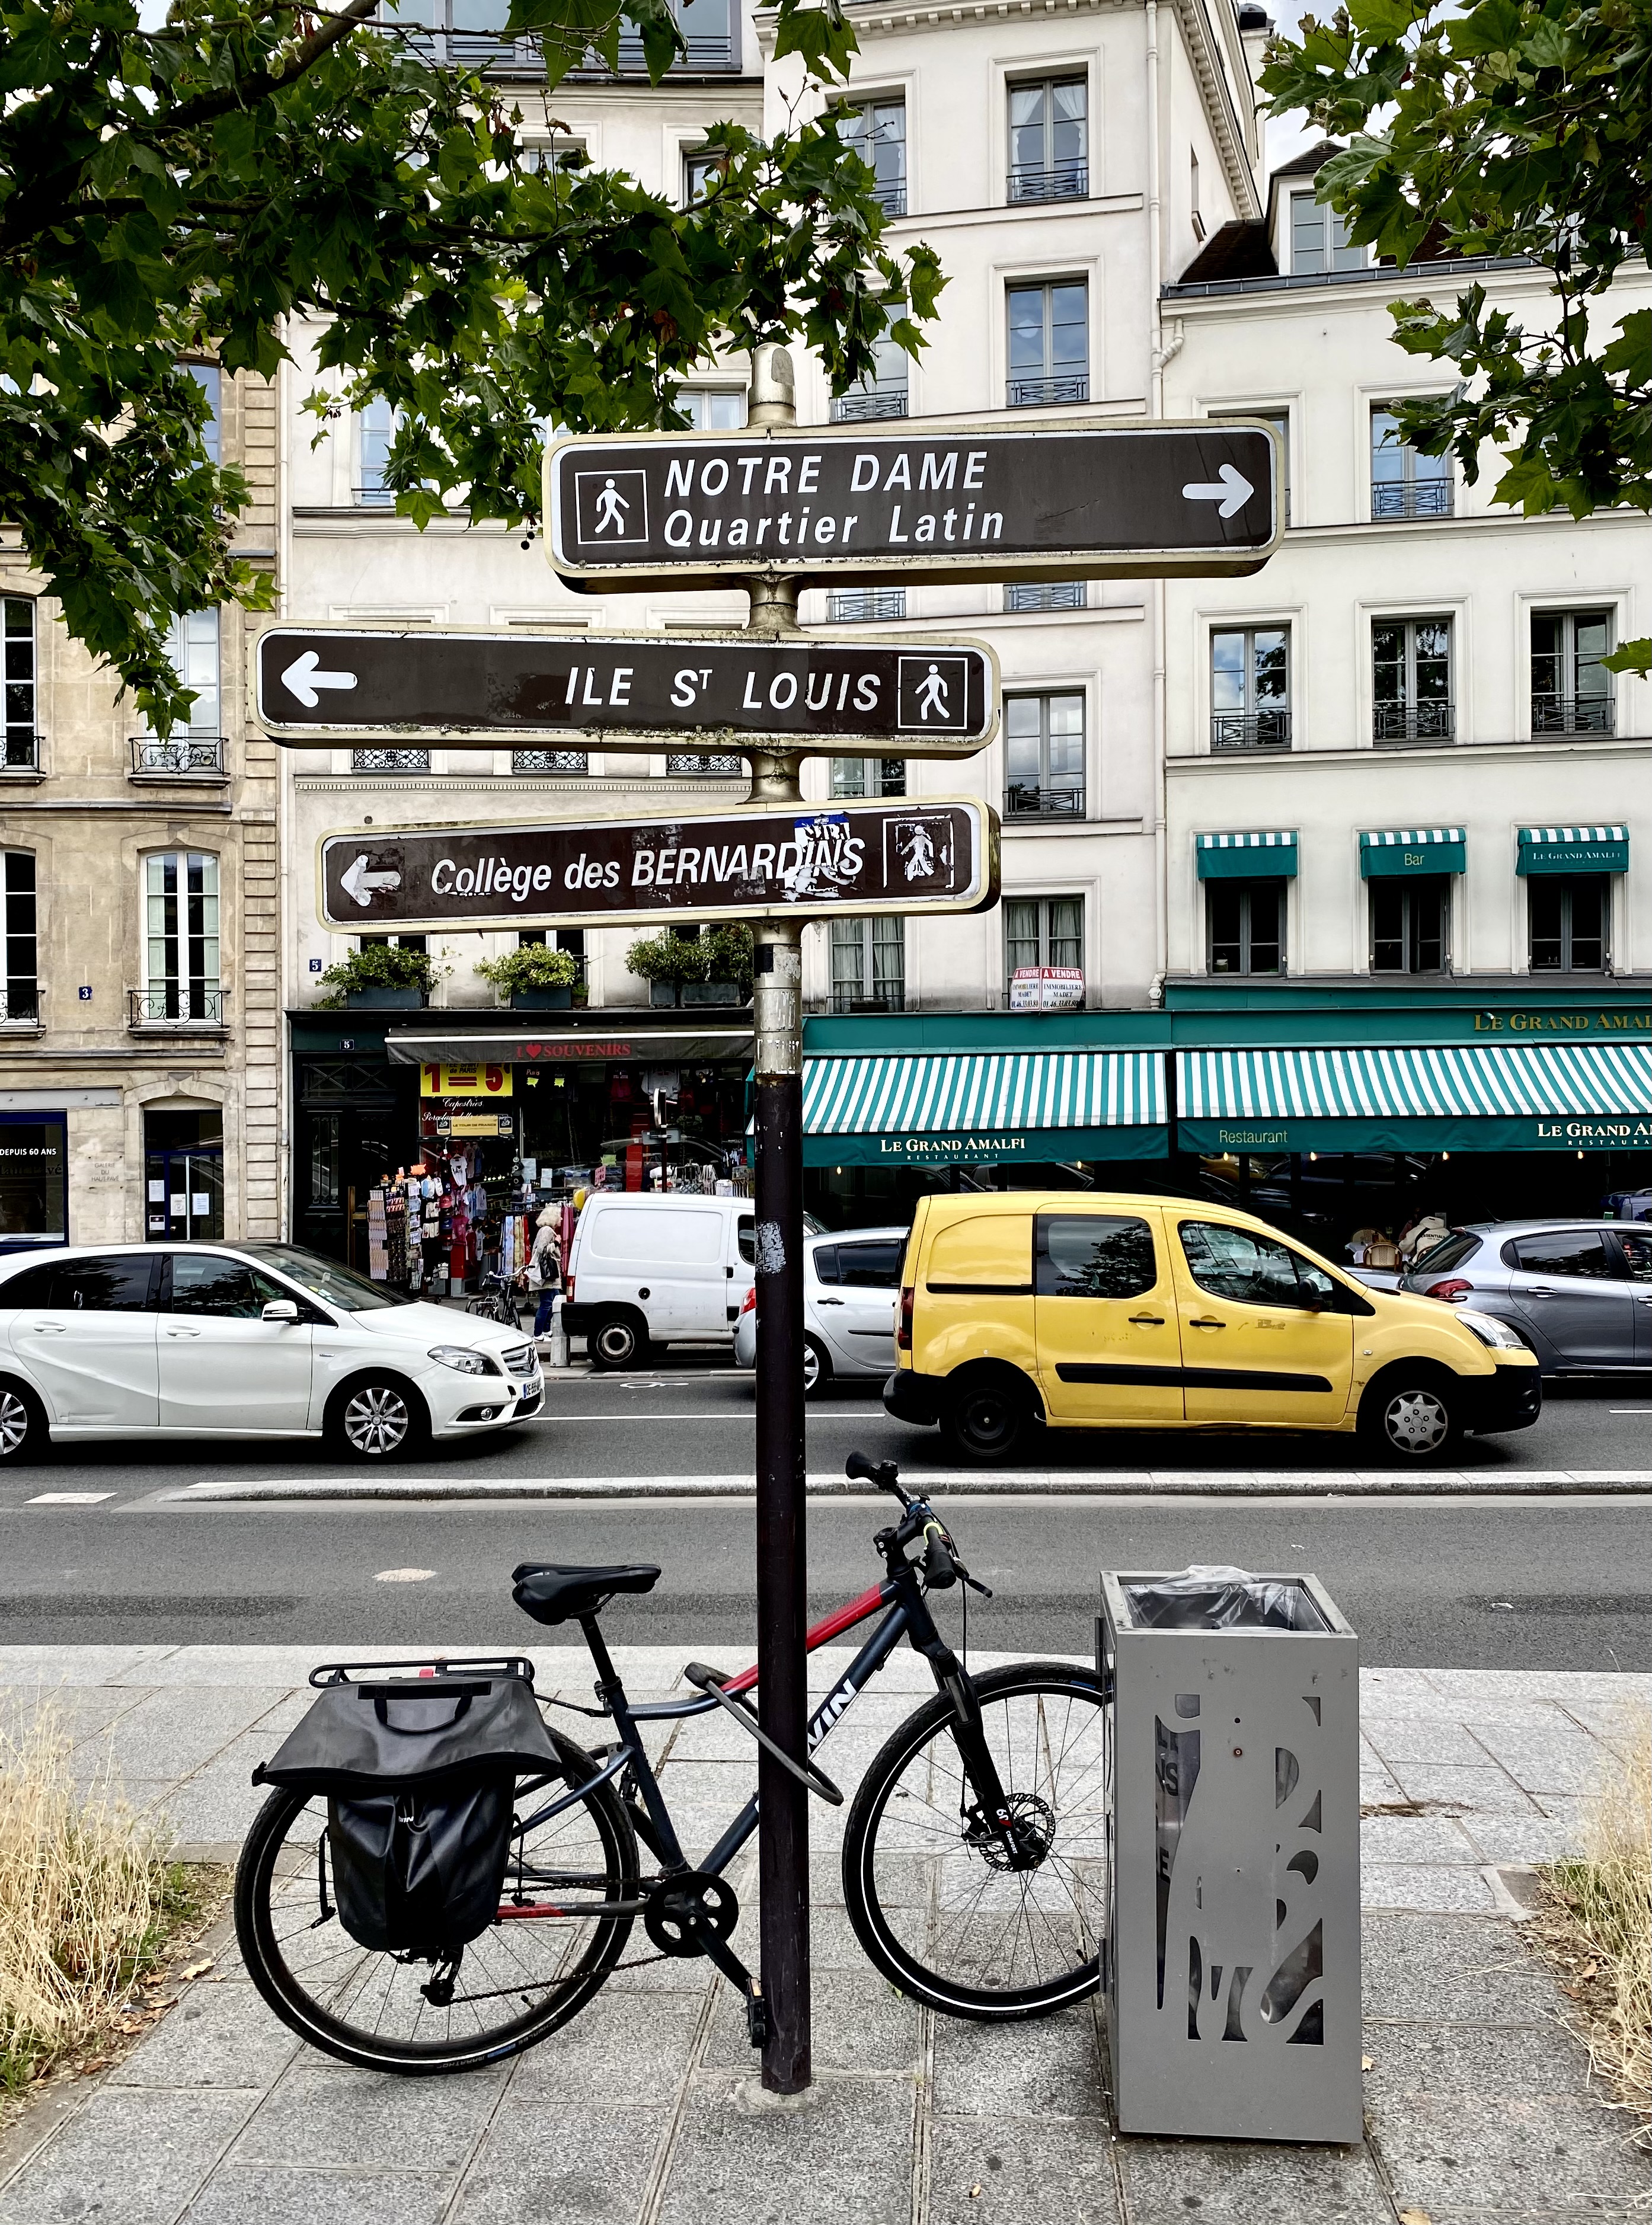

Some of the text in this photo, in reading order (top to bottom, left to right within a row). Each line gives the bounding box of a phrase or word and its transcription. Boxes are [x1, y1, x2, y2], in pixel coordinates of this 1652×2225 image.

[664, 452, 988, 497] NOTRE DAME
[664, 503, 1004, 547] Quartier Latin
[565, 667, 631, 706] ILE
[743, 672, 881, 711] LOUIS
[1404, 853, 1425, 866] Bar
[432, 837, 865, 901] Collège des BERNARDINS
[312, 961, 318, 971] 5
[1020, 969, 1039, 978] VENDRE
[1043, 969, 1081, 979] A VENDRE
[82, 988, 89, 999] 3
[1474, 1014, 1504, 1031] LE
[1510, 1014, 1589, 1030] GRAND
[516, 1043, 631, 1058] I SOUVENIRS
[424, 1063, 440, 1092] 1
[1219, 1130, 1288, 1143] Restaurant
[1538, 1123, 1562, 1137] LE
[1567, 1123, 1631, 1137] GRAND
[881, 1137, 1025, 1152] LE GRAND AMALFI
[1005, 1830, 1018, 1854] COMFORT
[518, 2016, 558, 2046] SCHWALBE
